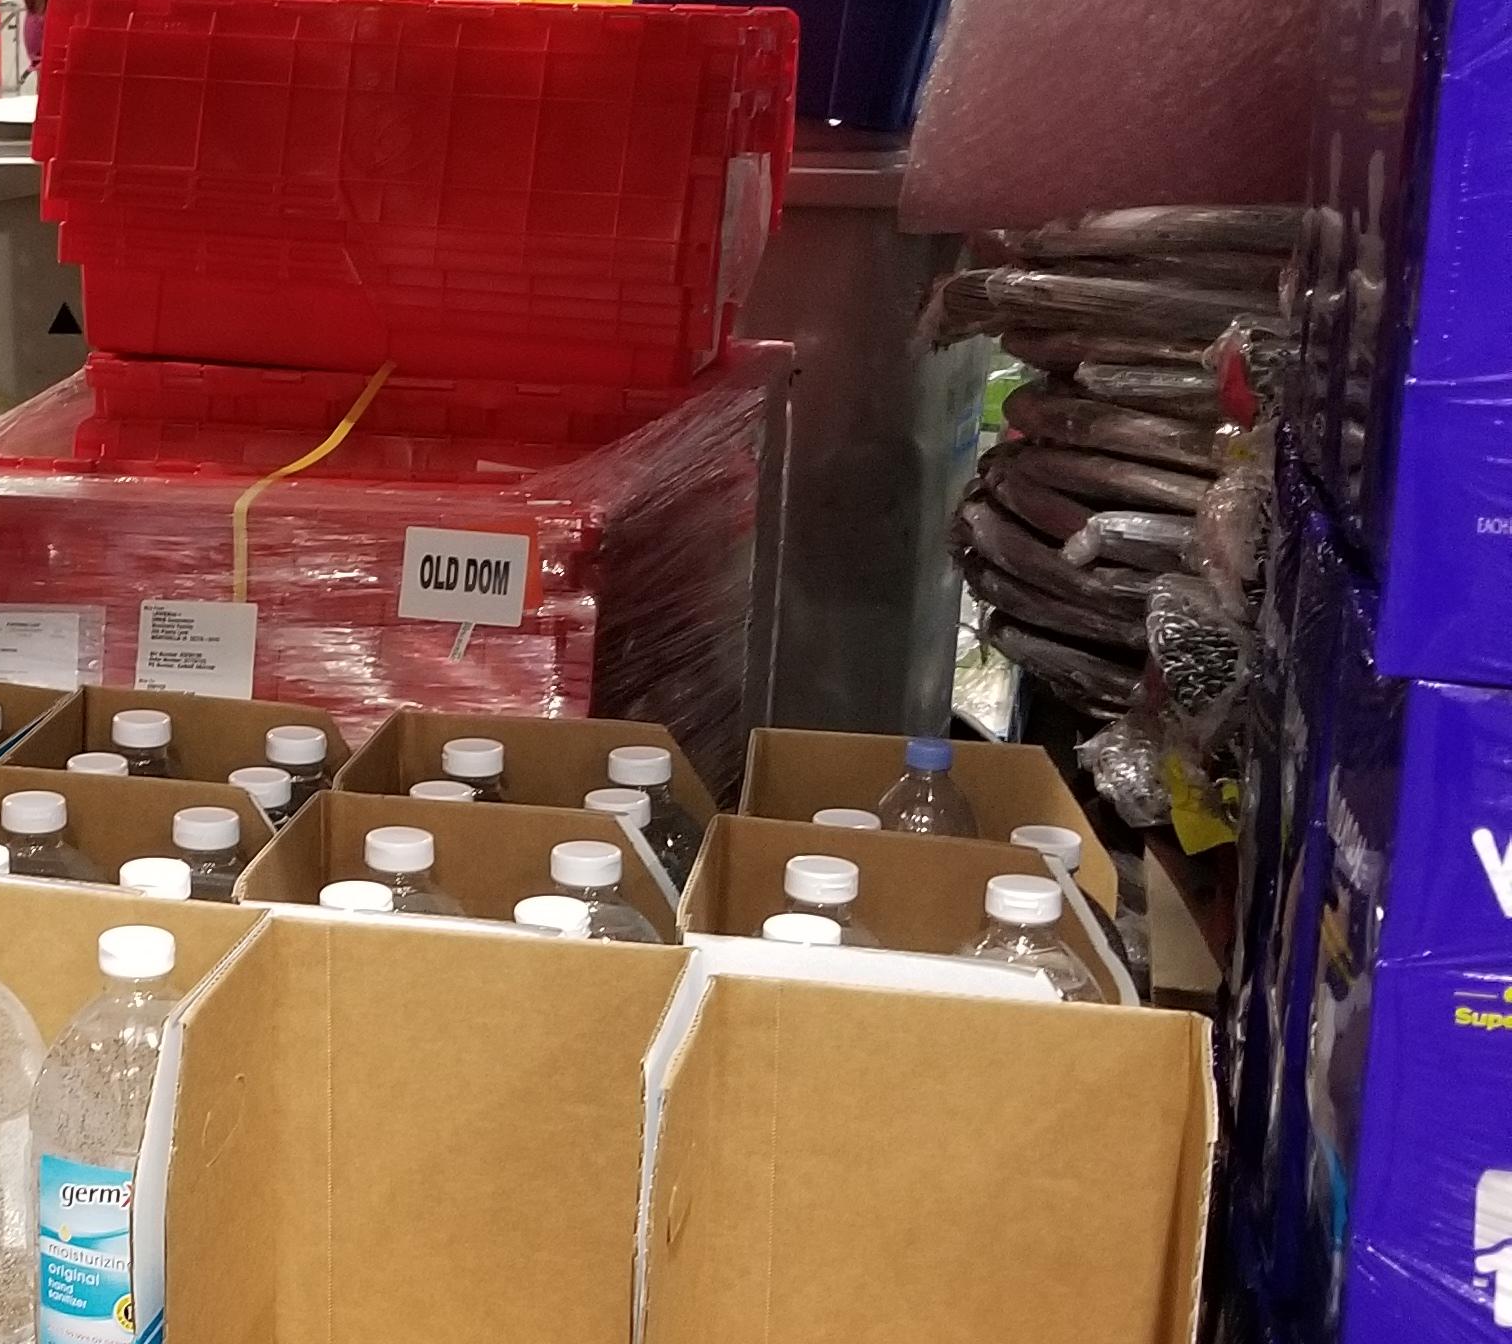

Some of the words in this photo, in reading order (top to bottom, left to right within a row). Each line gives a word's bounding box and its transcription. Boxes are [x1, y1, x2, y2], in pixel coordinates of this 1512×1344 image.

[419, 554, 459, 591] OLD
[464, 558, 511, 596] DOM
[48, 1263, 100, 1287] original
